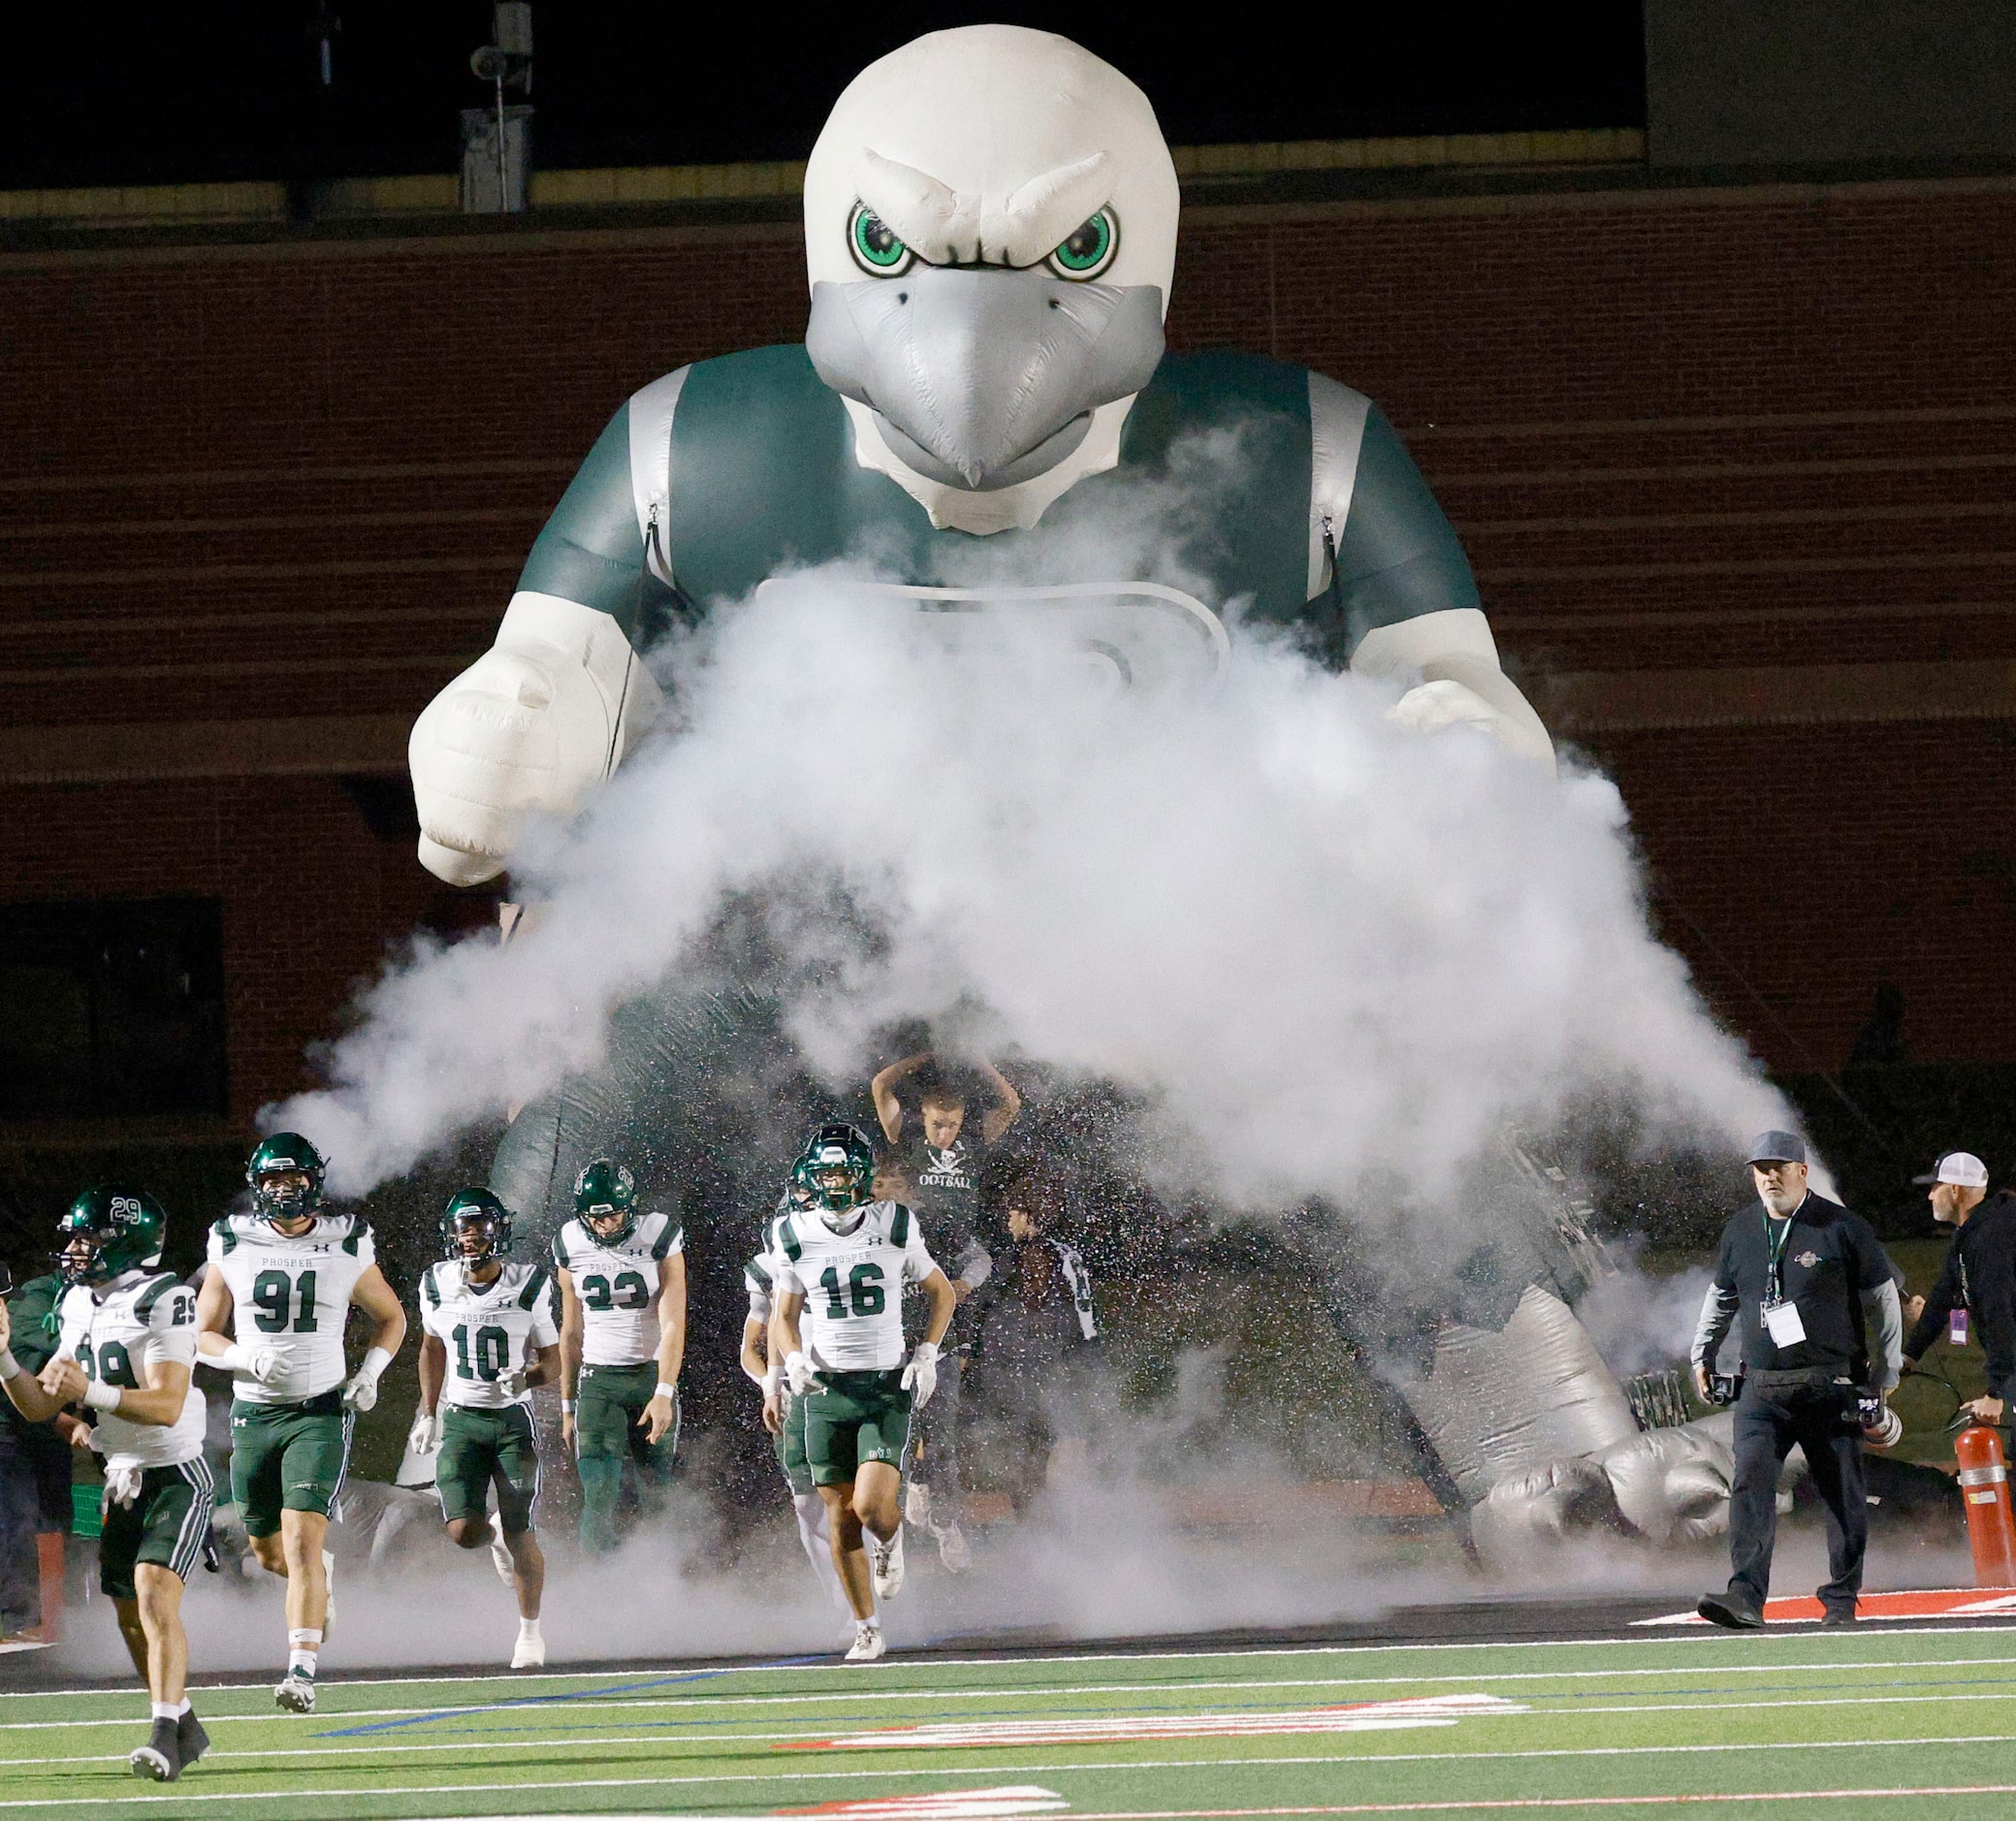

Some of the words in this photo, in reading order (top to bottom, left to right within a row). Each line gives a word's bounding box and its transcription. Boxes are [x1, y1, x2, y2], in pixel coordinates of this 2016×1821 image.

[110, 1197, 142, 1225] 29
[262, 1258, 312, 1267] PROSPER
[825, 1251, 872, 1265] PROSPER
[253, 1269, 318, 1333] 91
[582, 1271, 650, 1311] 23
[820, 1263, 885, 1320] 16
[455, 1313, 498, 1324] PROSPER
[452, 1325, 509, 1382] 10
